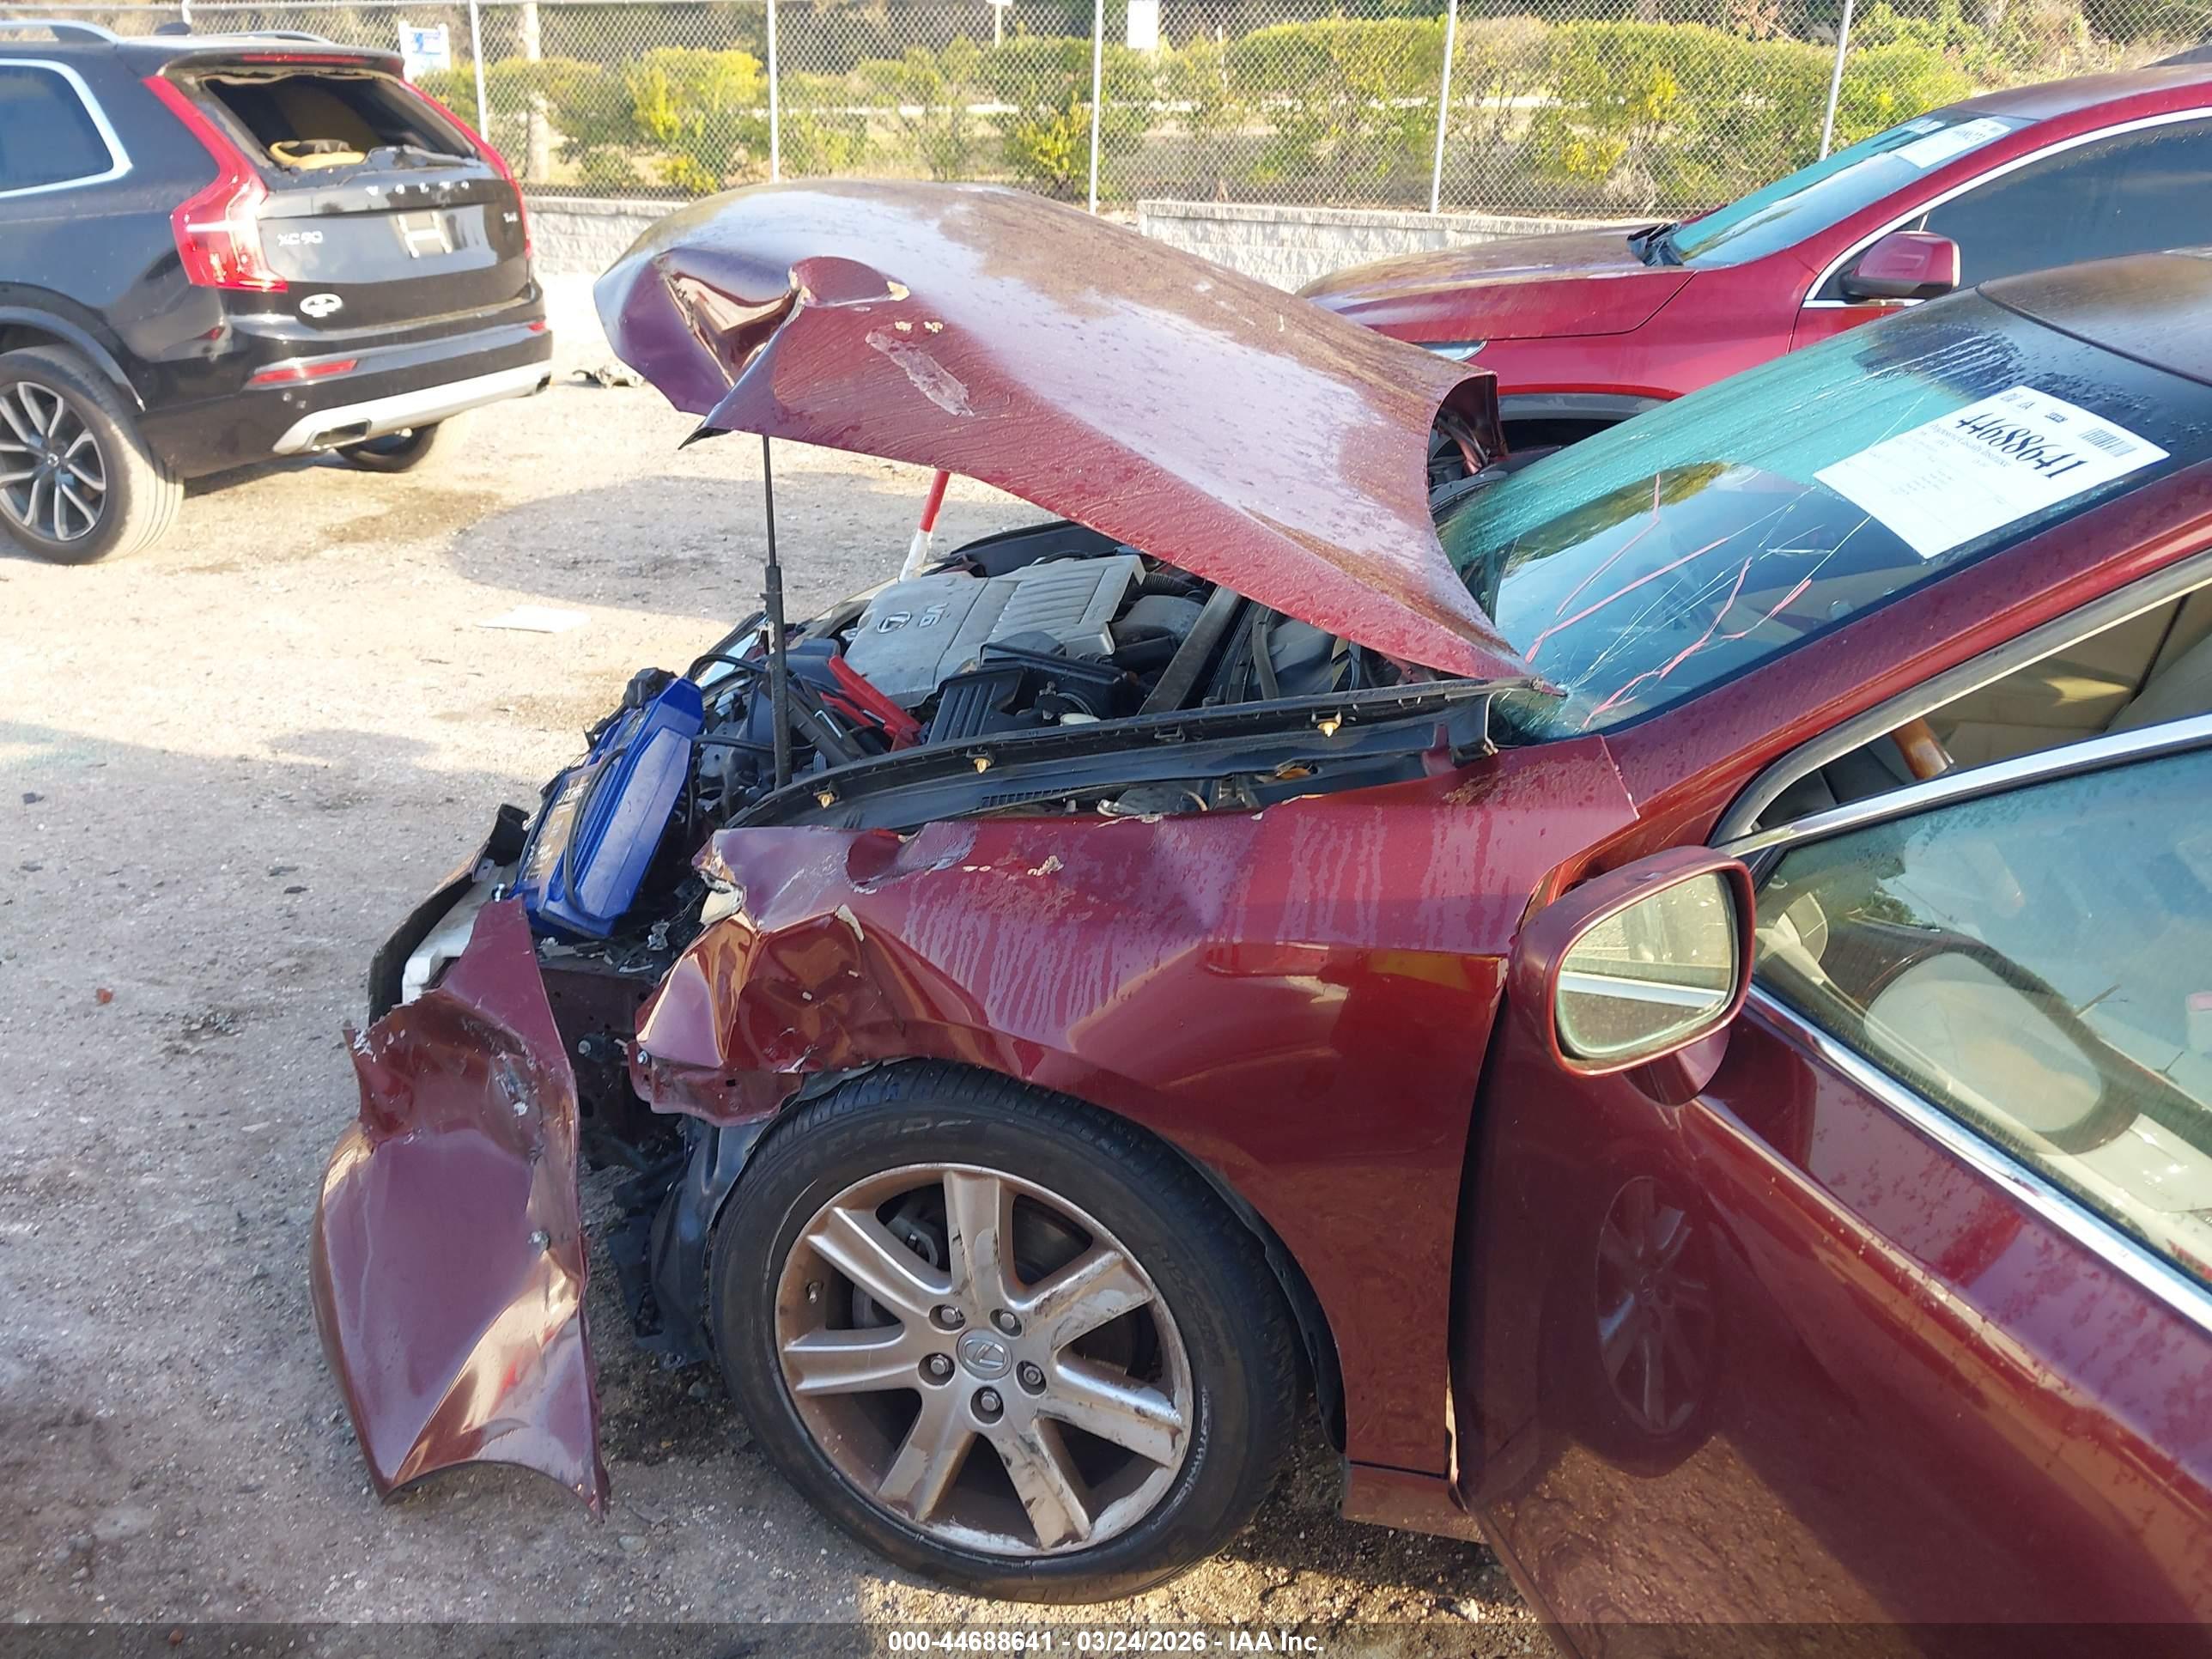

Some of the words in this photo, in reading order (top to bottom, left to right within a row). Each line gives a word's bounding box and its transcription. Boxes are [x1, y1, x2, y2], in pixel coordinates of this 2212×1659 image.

[365, 180, 470, 197] VOLVO
[276, 230, 324, 247] XC90
[1954, 411, 2089, 479] 44688641
